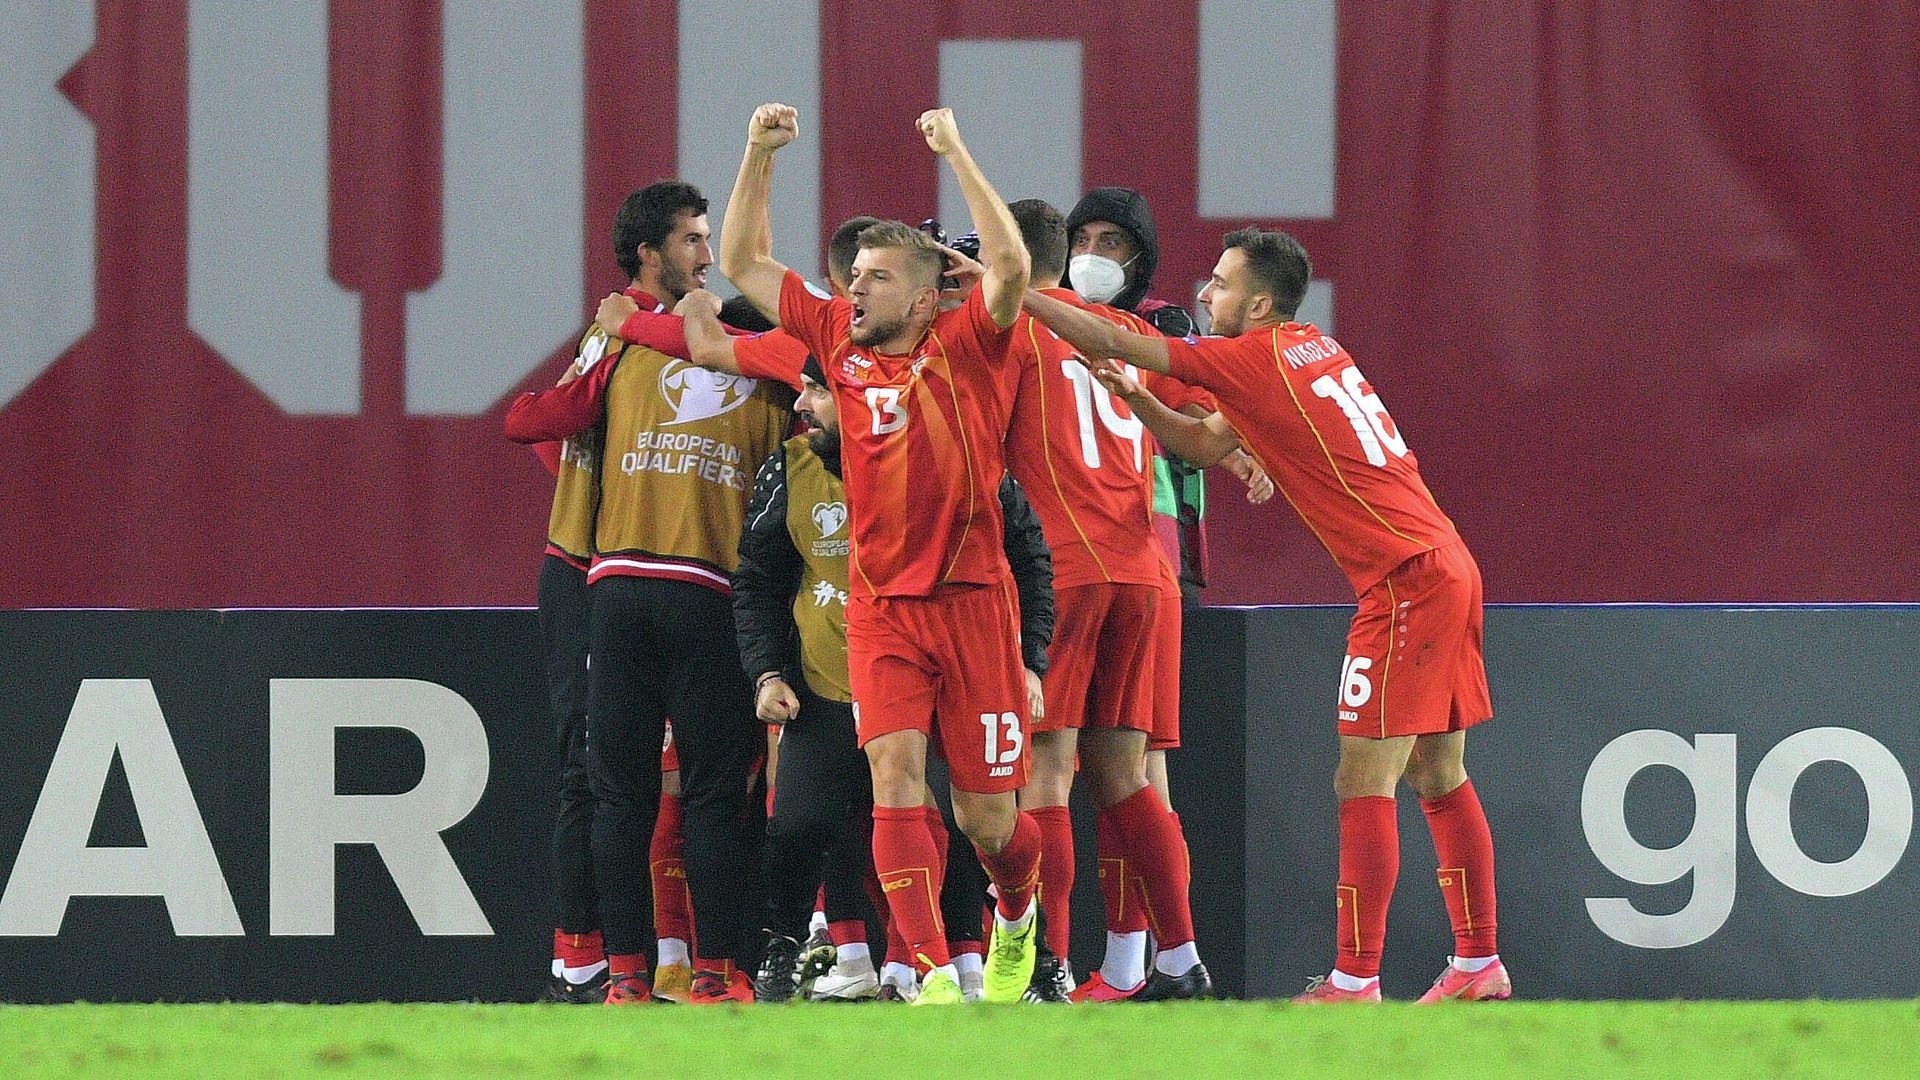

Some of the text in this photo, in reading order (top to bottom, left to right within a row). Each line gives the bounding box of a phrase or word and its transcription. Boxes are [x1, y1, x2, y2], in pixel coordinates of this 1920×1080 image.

[864, 387, 908, 435] 13
[1311, 365, 1409, 468] 16
[621, 451, 747, 492] QUALIFIERS
[637, 431, 741, 465] EUROPEAN
[980, 711, 1023, 764] 13
[989, 766, 1013, 777] JAKO
[0, 678, 495, 936] AR
[1580, 727, 1914, 949] go
